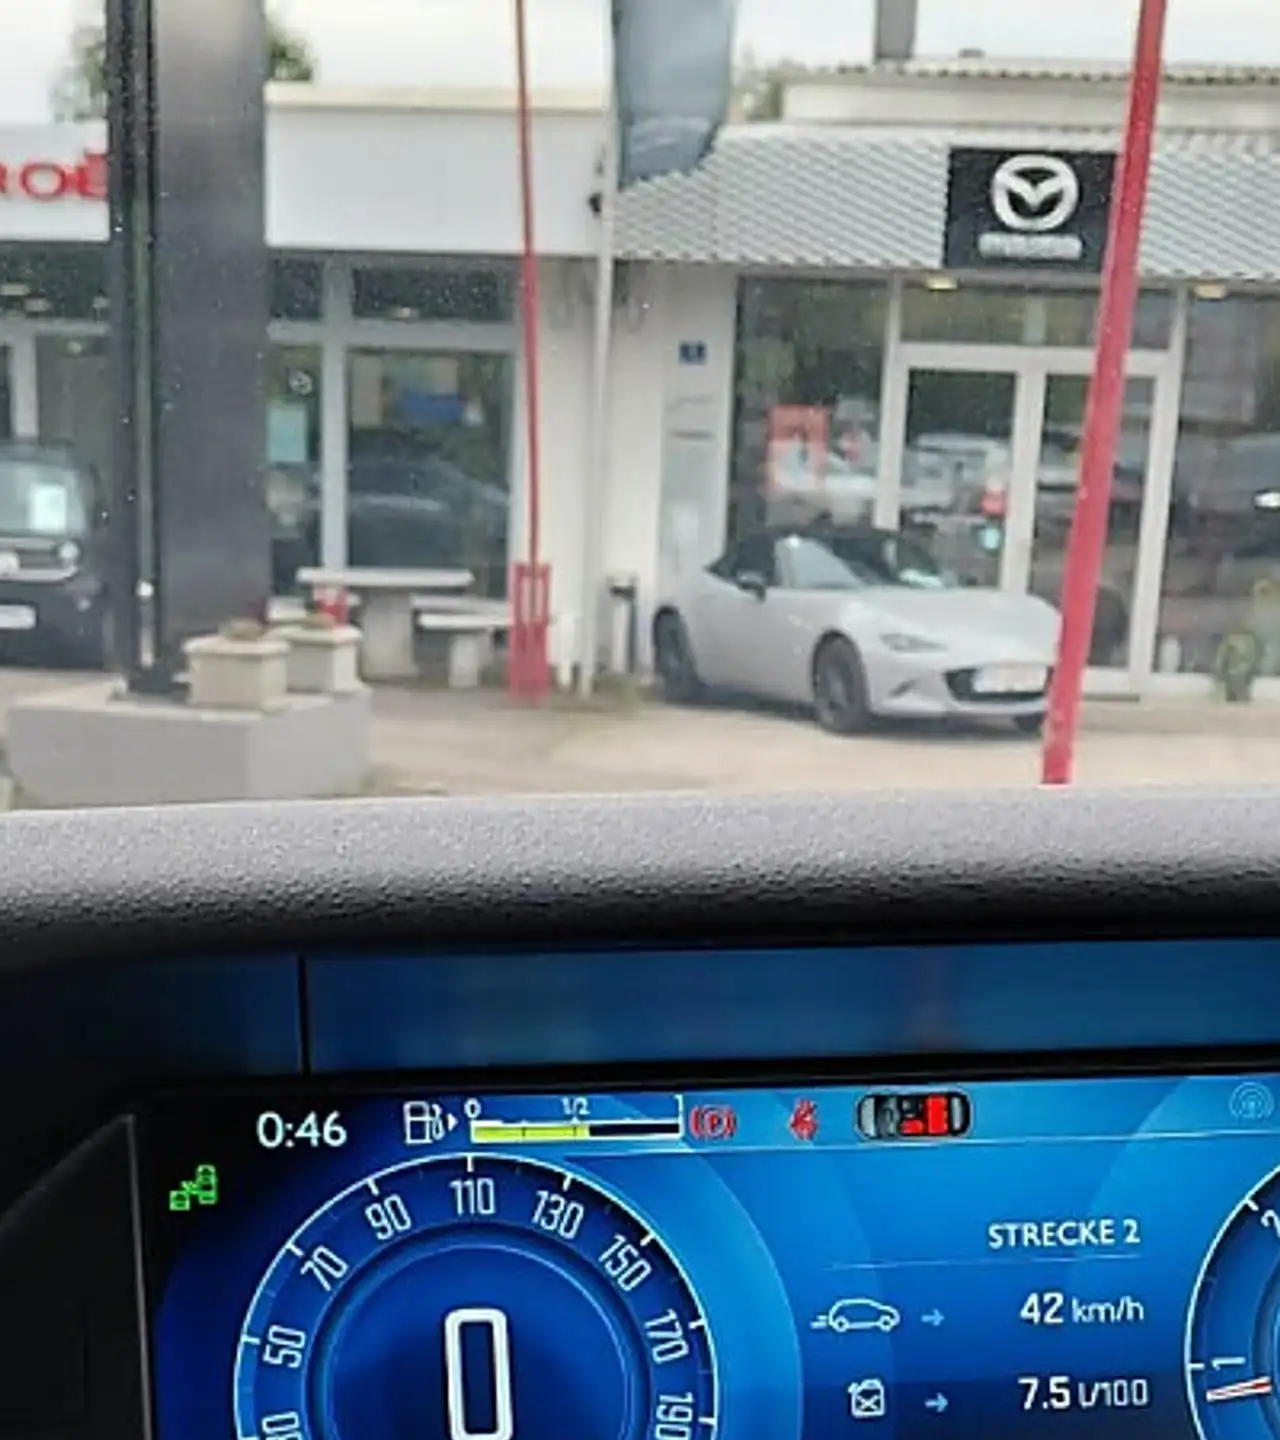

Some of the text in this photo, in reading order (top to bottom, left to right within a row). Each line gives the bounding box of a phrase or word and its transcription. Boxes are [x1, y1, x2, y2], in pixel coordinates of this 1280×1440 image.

[464, 1099, 481, 1119] 0
[562, 1097, 590, 1117] 1/2
[257, 1110, 347, 1147] 0:46
[449, 1178, 495, 1216] 110
[532, 1190, 584, 1240] 130
[365, 1194, 412, 1240] 90
[988, 1218, 1141, 1250] STRECKE 2
[300, 1245, 349, 1291] 70
[598, 1234, 652, 1292] 150
[1020, 1291, 1145, 1325] 42 km/h
[262, 1324, 306, 1368] 50
[644, 1308, 690, 1364] 170
[1212, 1356, 1246, 1371] 1
[1018, 1375, 1070, 1410] 7.5
